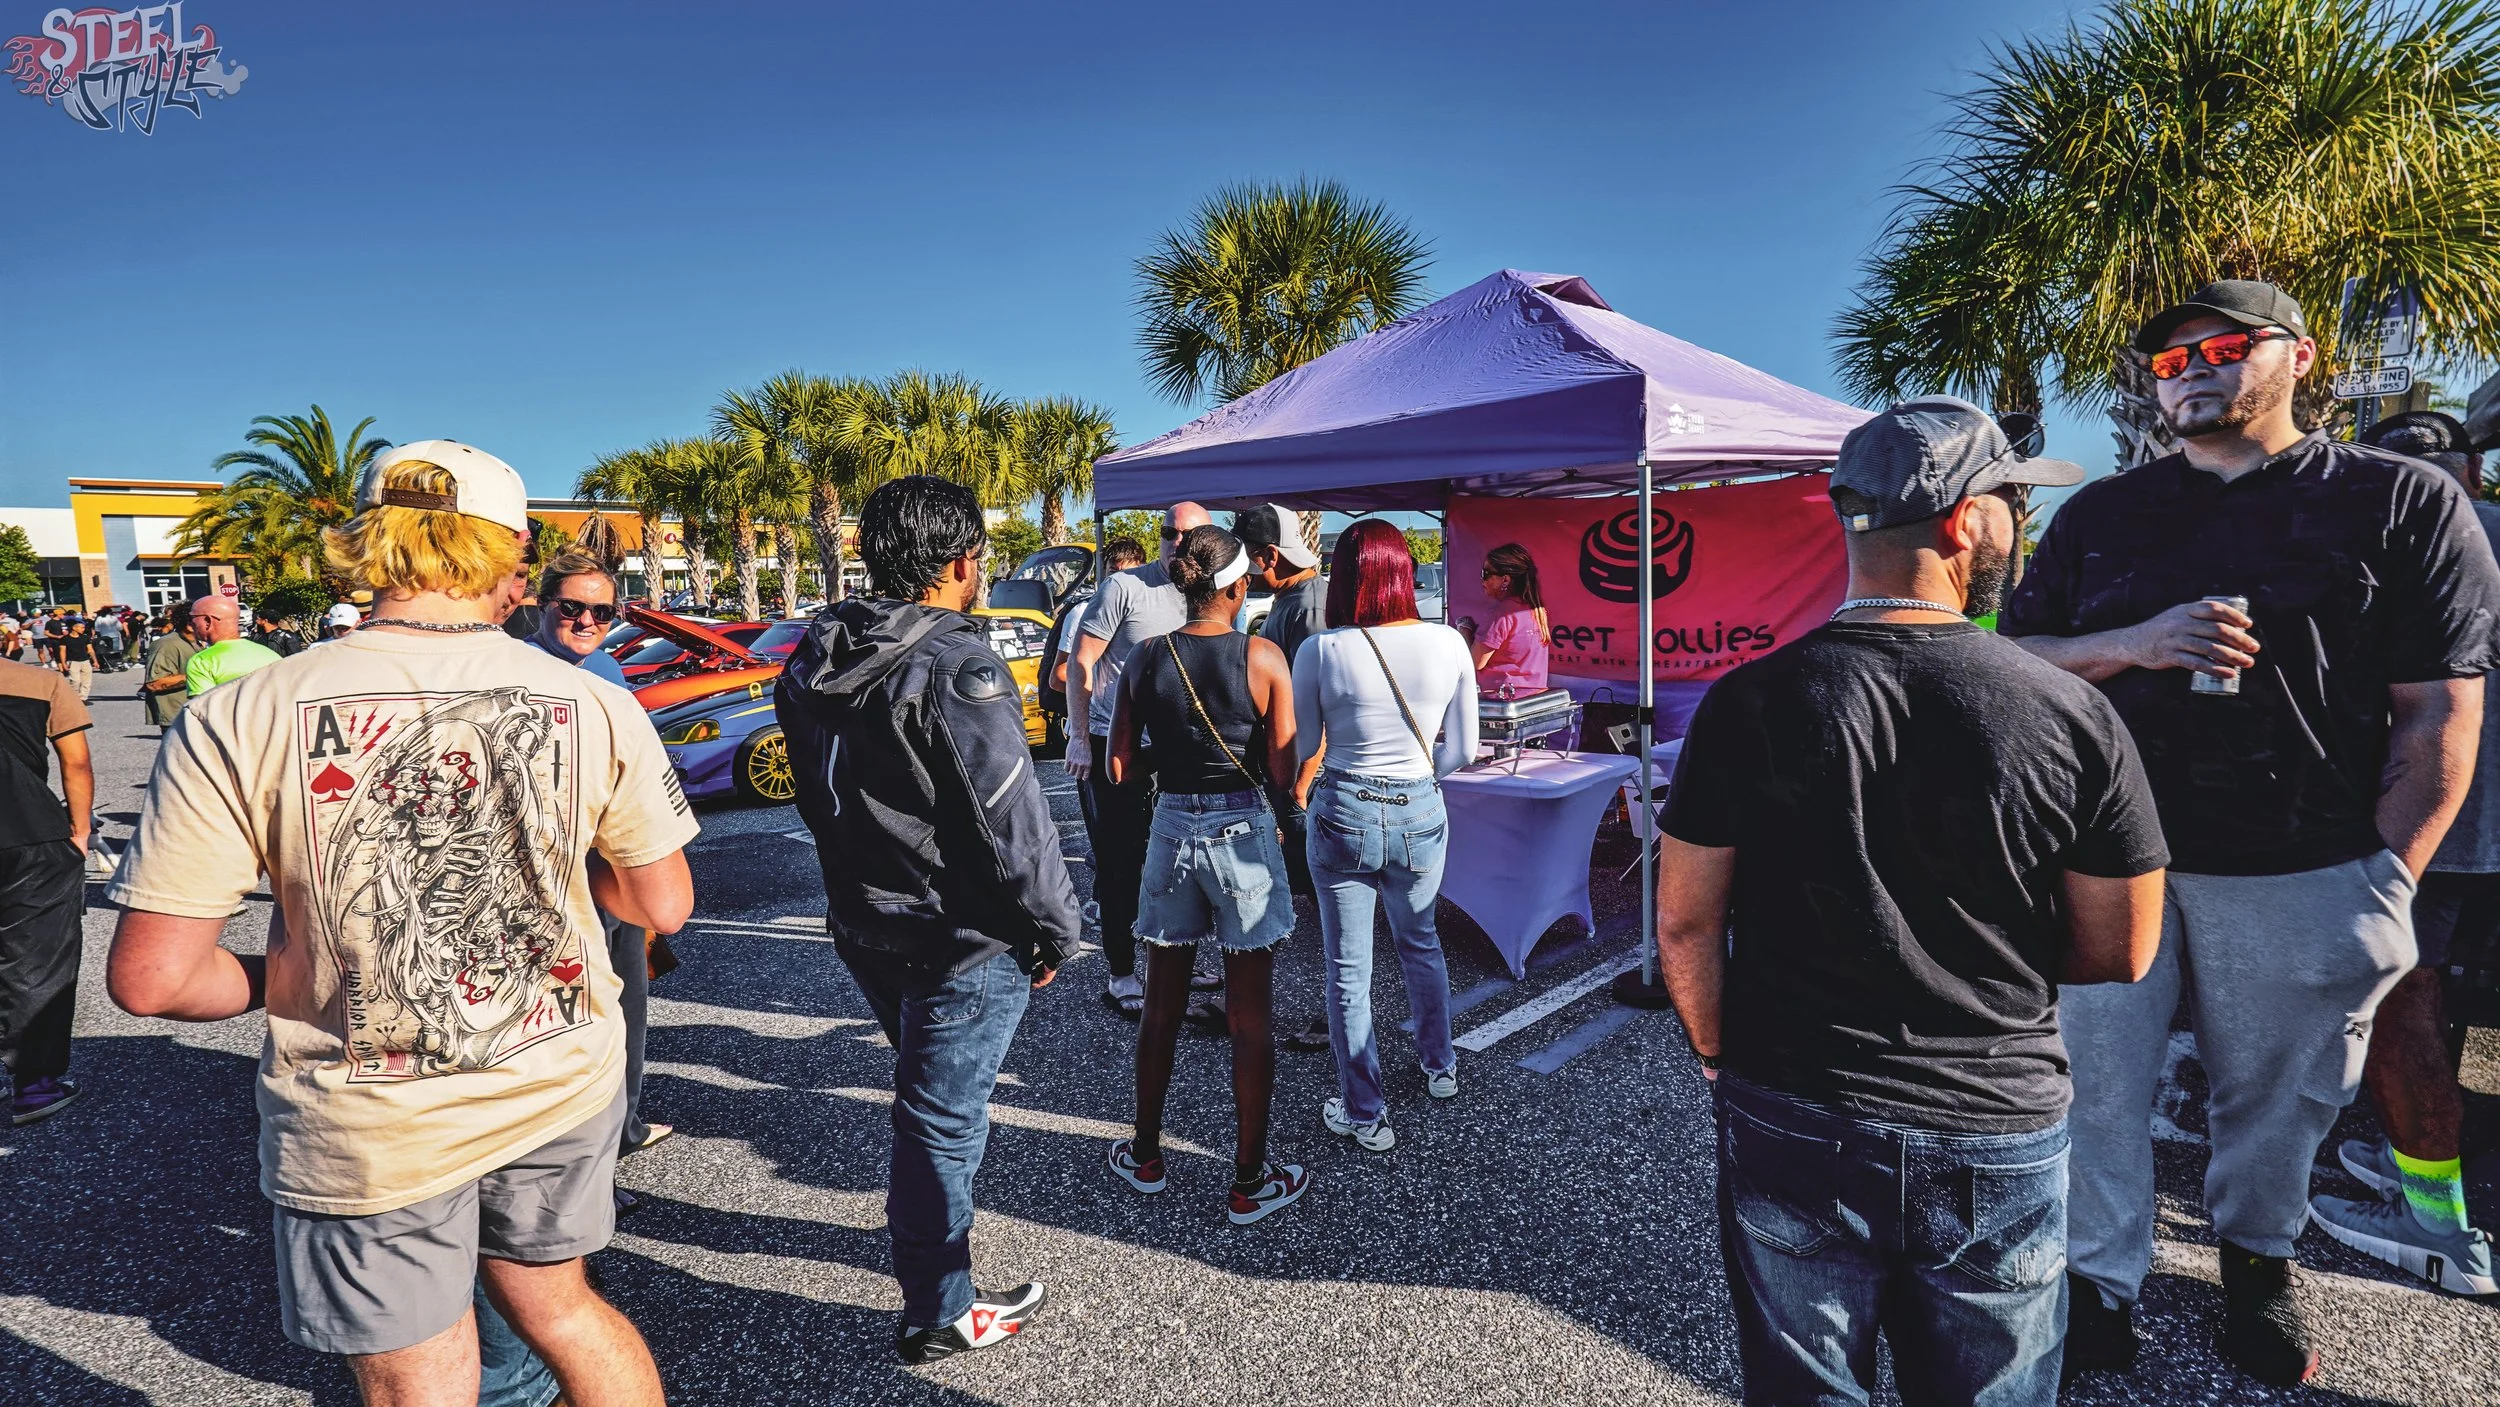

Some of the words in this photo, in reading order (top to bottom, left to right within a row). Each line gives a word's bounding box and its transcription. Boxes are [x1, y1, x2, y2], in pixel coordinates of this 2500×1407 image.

[2377, 370, 2405, 382] FINE
[1654, 620, 1776, 654] ollies
[1549, 653, 1582, 664] REAT
[308, 704, 351, 759] A
[347, 970, 368, 1032] WARRIOR
[550, 985, 584, 1027] A
